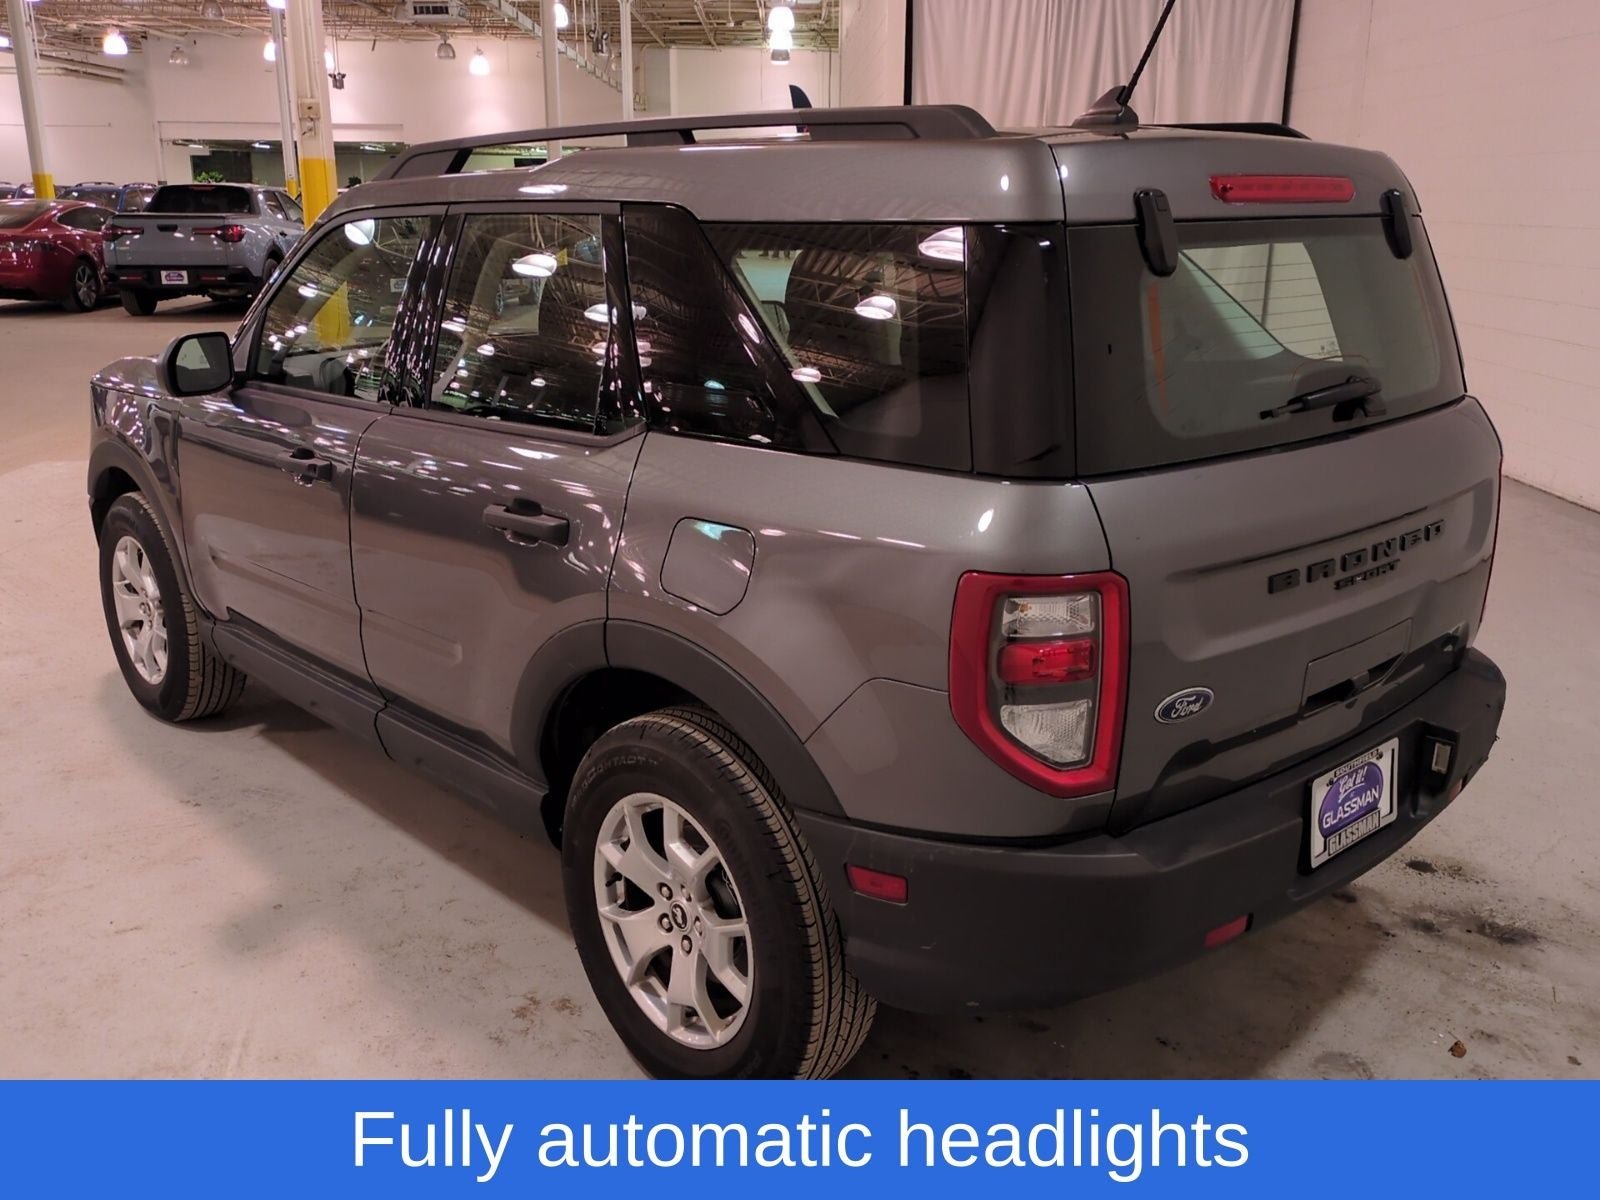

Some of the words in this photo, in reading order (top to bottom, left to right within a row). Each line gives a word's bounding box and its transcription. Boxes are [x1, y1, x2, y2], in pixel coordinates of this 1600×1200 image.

[1267, 518, 1445, 595] BRONCO
[1170, 693, 1206, 721] Ford
[1322, 784, 1380, 829] GLASSMAN
[1329, 812, 1379, 854] GLASSMAN
